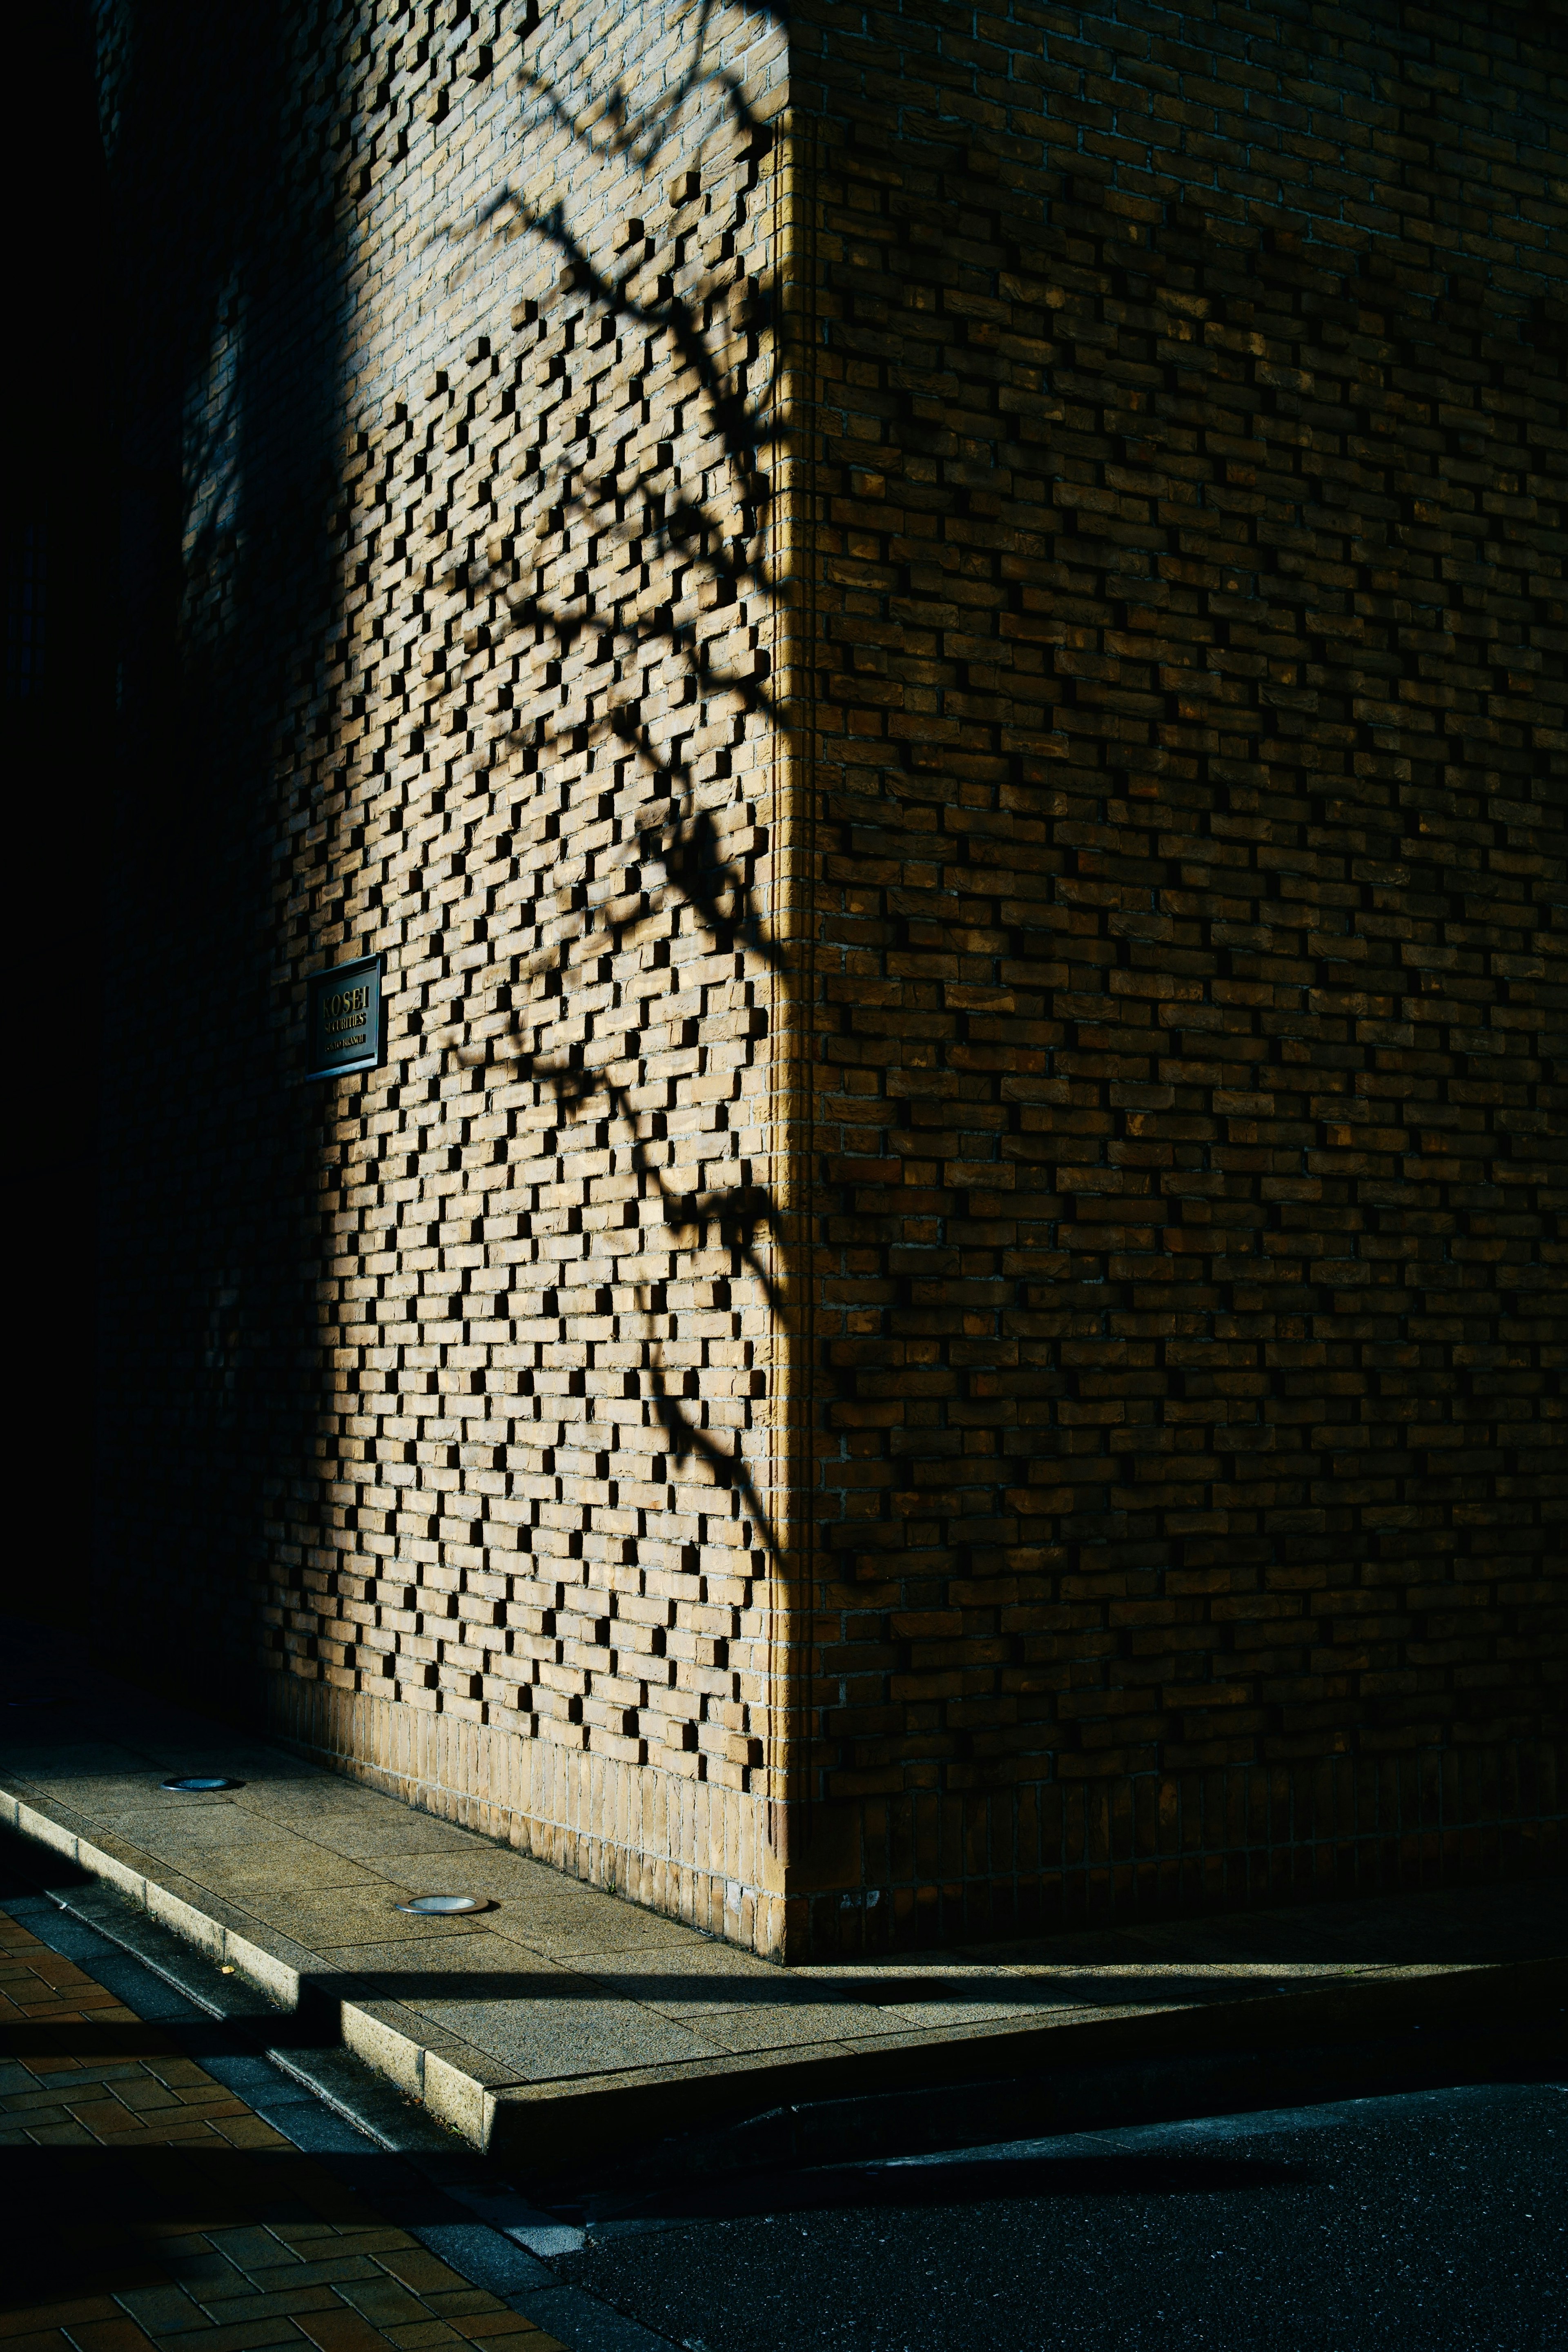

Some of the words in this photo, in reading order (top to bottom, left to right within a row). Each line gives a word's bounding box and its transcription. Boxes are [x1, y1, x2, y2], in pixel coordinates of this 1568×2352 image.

[323, 986, 368, 1018] KOSEI
[325, 1013, 365, 1033] SECURITIES
[325, 1040, 341, 1052] TOKYO
[343, 1034, 364, 1047] BRANCH
